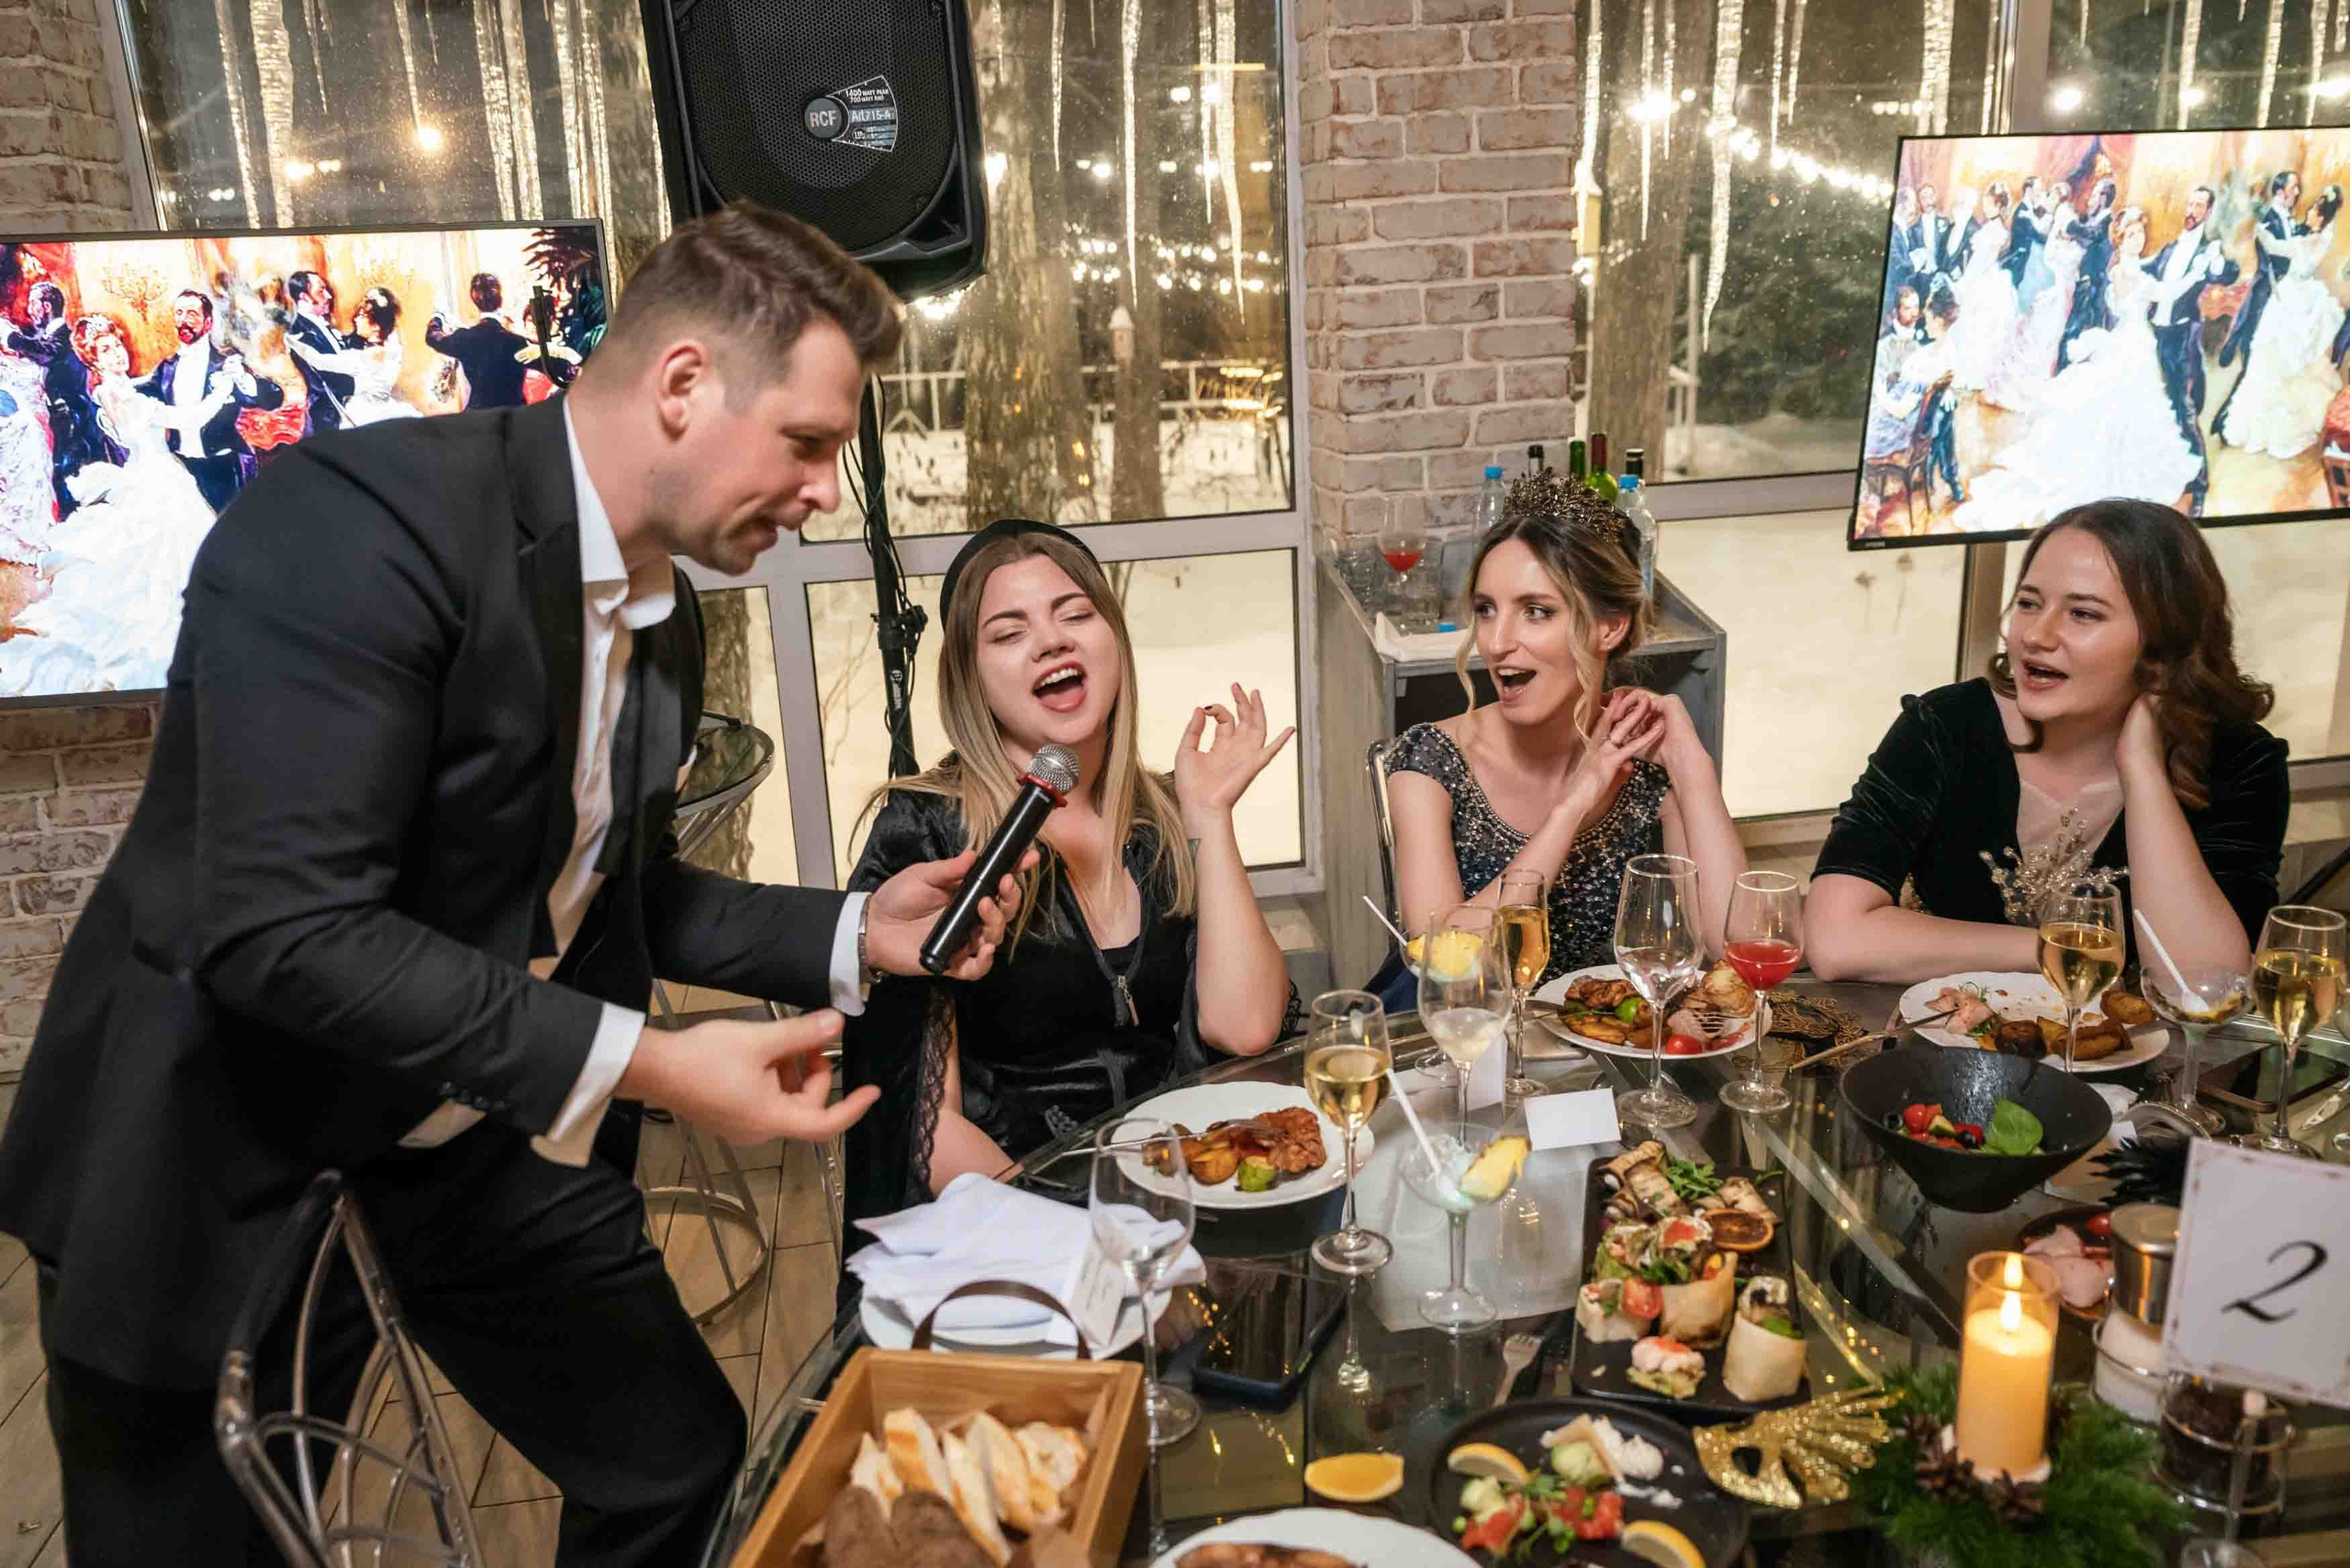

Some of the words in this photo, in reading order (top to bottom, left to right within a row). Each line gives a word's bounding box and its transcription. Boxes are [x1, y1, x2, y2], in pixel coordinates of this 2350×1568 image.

[845, 88, 862, 97] 1400
[809, 109, 837, 128] RCF
[2221, 1240, 2327, 1324] 2
